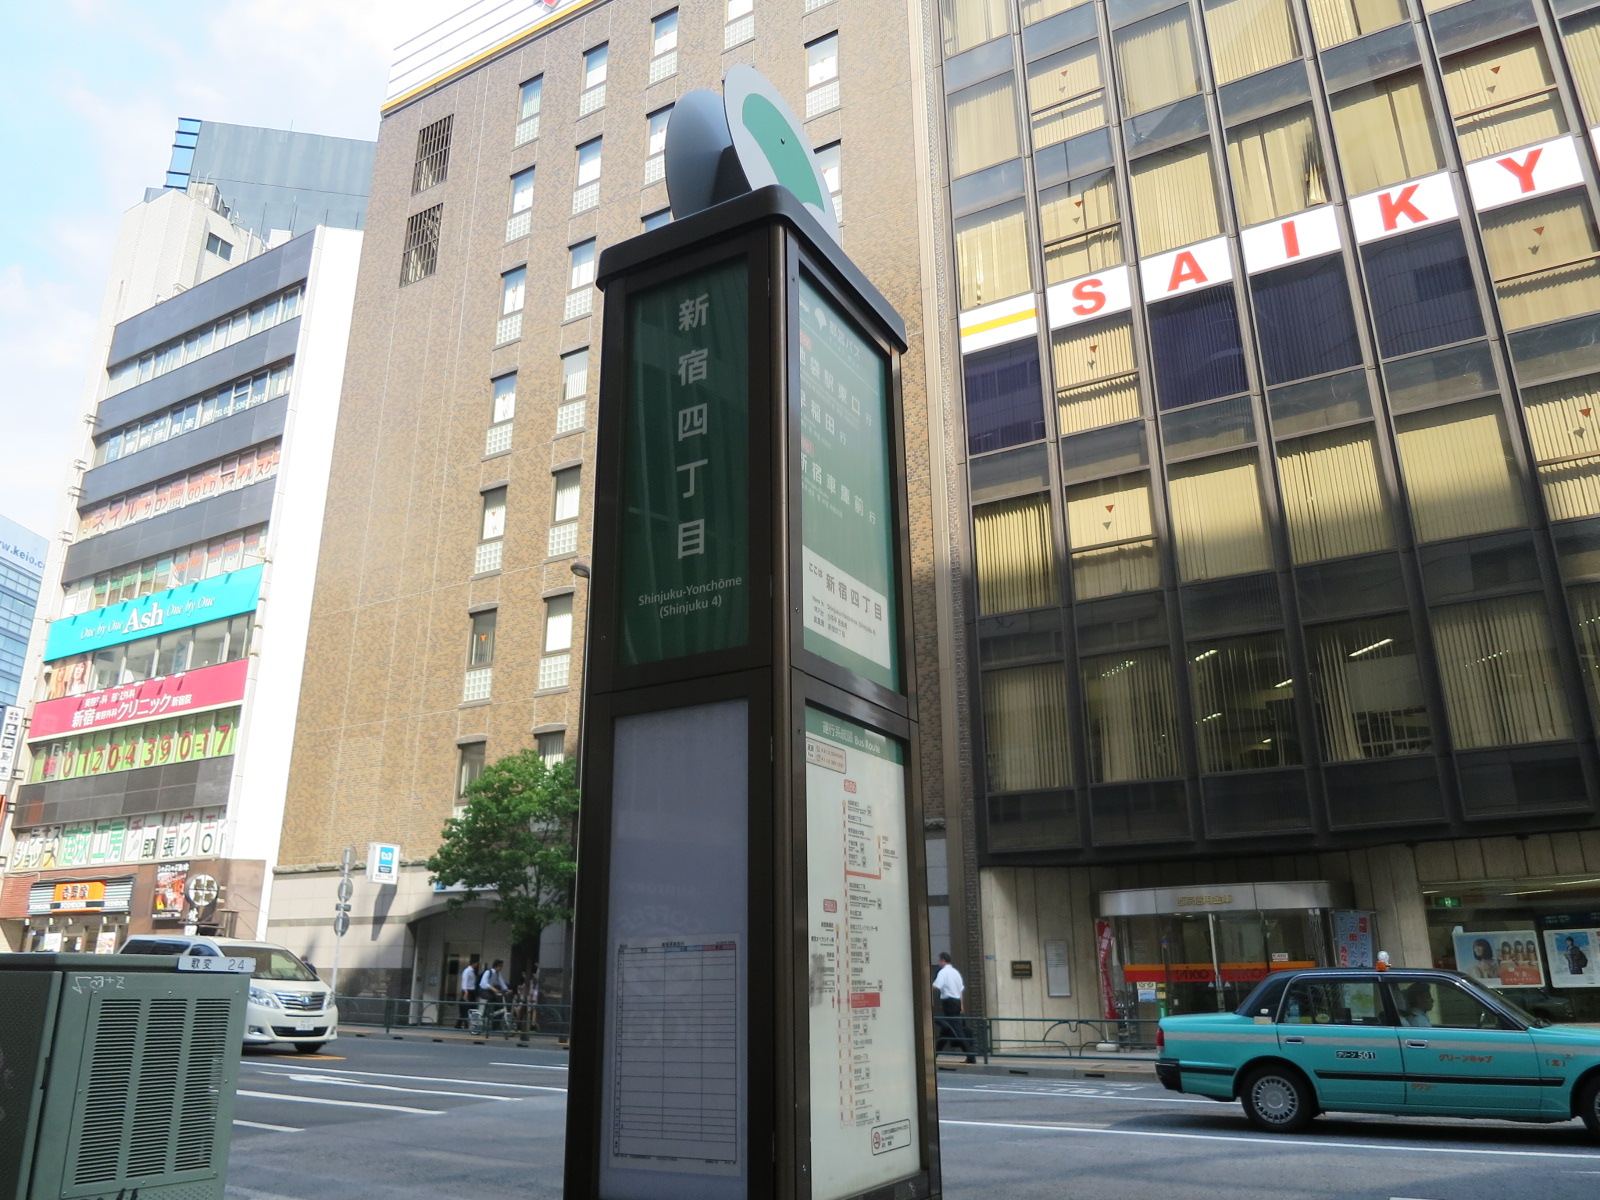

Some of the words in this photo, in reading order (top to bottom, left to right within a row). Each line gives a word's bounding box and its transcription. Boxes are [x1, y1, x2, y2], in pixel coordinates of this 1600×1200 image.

[675, 292, 710, 560] 新宿四丁目
[637, 575, 743, 606] Shinjuku-Yonchōme
[825, 572, 882, 622] 新宿四丁目
[80, 624, 96, 640] One
[96, 621, 107, 639] by
[108, 617, 125, 632] One
[122, 602, 164, 634] Ash
[166, 603, 183, 617] One
[184, 599, 197, 616] by
[197, 595, 215, 609] One
[659, 599, 709, 619] (Shinjuku
[710, 594, 722, 609] 4)
[854, 735, 864, 748] Bus
[865, 739, 881, 754] Route
[227, 958, 245, 971] 24
[1358, 1051, 1374, 1060] 501
